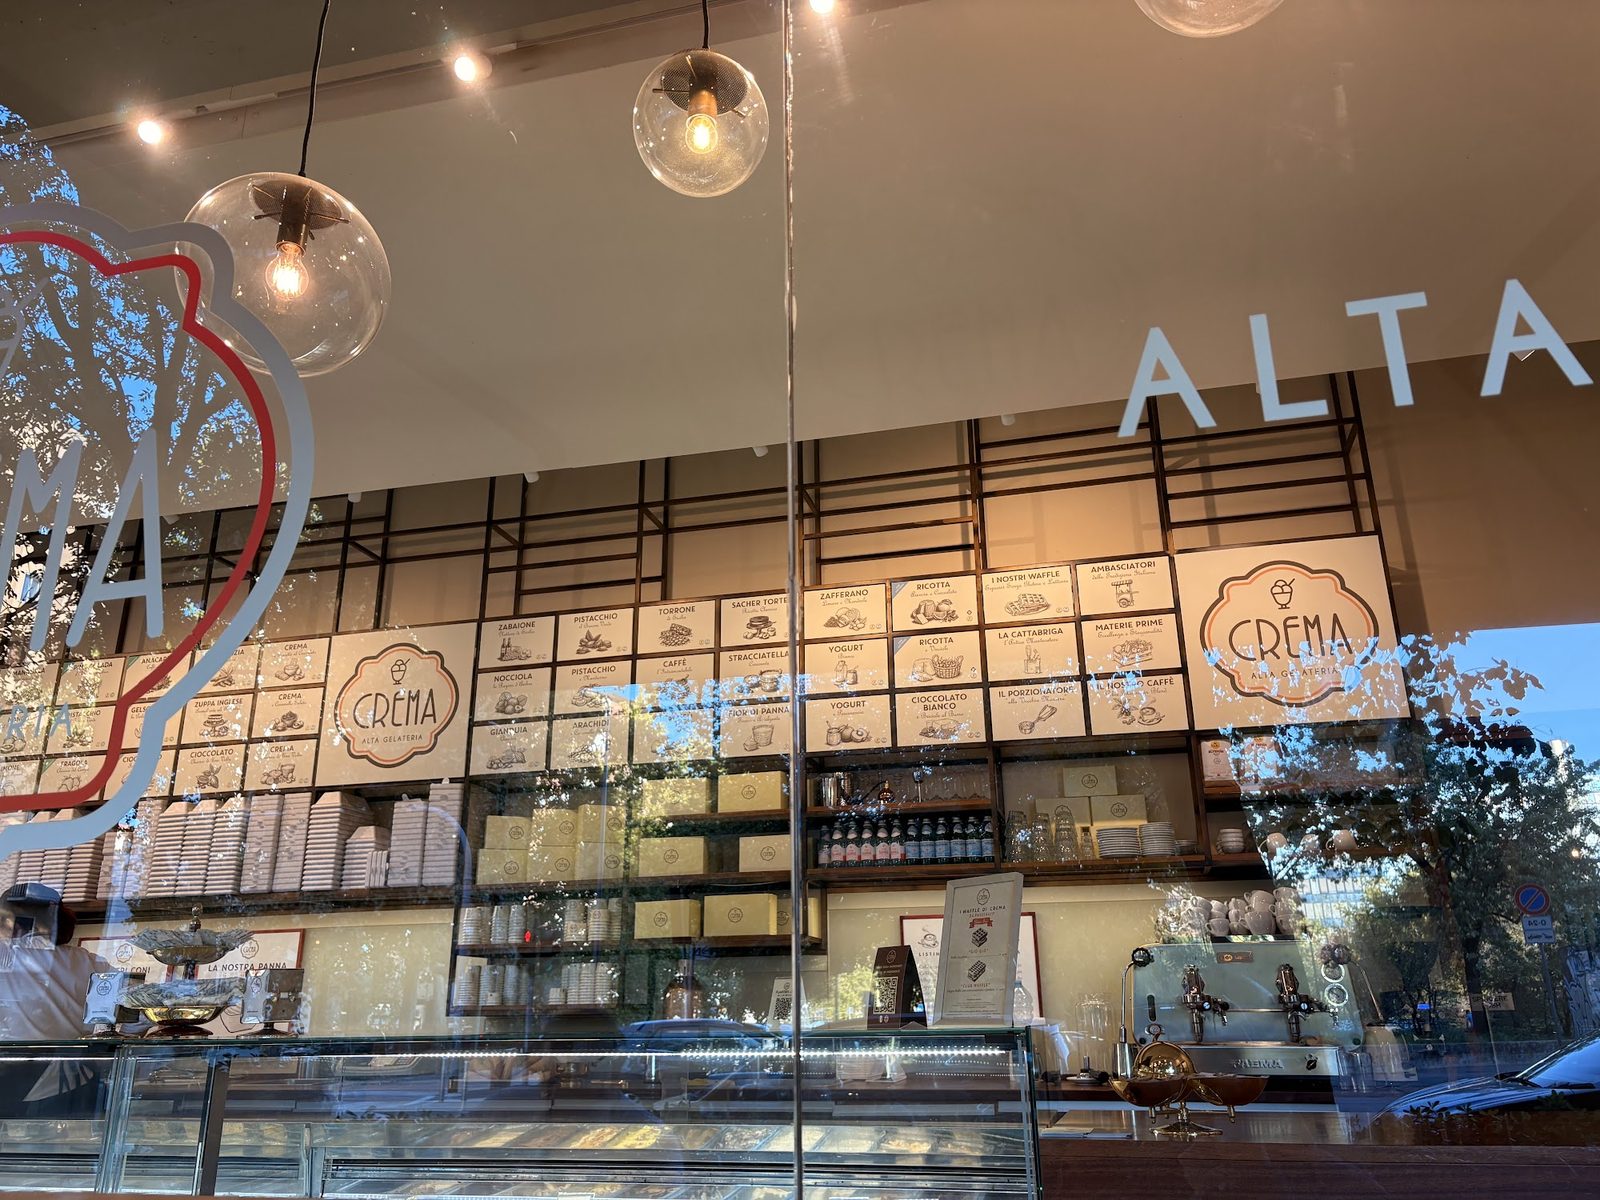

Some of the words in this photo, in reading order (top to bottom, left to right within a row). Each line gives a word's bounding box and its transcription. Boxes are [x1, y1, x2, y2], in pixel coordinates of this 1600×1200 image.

[1118, 278, 1594, 438] ALTA
[1091, 561, 1156, 573] AMBASCIATORI
[997, 574, 1026, 583] NOSTRI
[1028, 571, 1060, 580] WAFFLE
[916, 581, 950, 590] RICOTTA
[820, 589, 869, 600] ZAFFERANO
[732, 600, 761, 609] SACHER
[763, 597, 788, 605] TORTE
[659, 606, 696, 615] TORRONE
[574, 613, 618, 623] PISTACCHIO
[498, 621, 536, 631] ZABAIONE
[1095, 621, 1133, 631] MATERIE
[1136, 619, 1164, 628] PRIME
[1011, 627, 1064, 638] CATTABRIGA
[1228, 613, 1353, 661] CREMA
[919, 636, 954, 646] RICOTTA
[284, 643, 308, 651] CREMA
[828, 643, 864, 653] YOGURT
[728, 651, 789, 662] STRACCIATELLA
[663, 657, 687, 667] CAFFÈ
[572, 665, 616, 675] PISTACCHIO
[1281, 667, 1339, 678] GEATERIA
[494, 673, 533, 682] NOCCIOLA
[1107, 681, 1144, 690] NOSO
[1147, 676, 1175, 687] CAFFÈ
[1008, 685, 1075, 697] PORZIONATORE
[278, 693, 302, 701] CREMA
[911, 693, 968, 703] CIOCCOLATO
[194, 700, 215, 708] ZUPPA
[216, 698, 243, 706] INGLESE
[830, 700, 866, 710] YOGURT
[923, 702, 957, 711] BIANCO
[353, 688, 437, 729] CREMA
[728, 709, 748, 718] FIOR
[761, 706, 790, 715] PANNA
[490, 726, 528, 736] GIANDUIA
[362, 737, 380, 745] ALTA
[383, 734, 423, 743] GELATERIA
[190, 749, 234, 759] CIOCCOLATO
[208, 964, 218, 972] LA
[221, 963, 254, 971] NOSTRA
